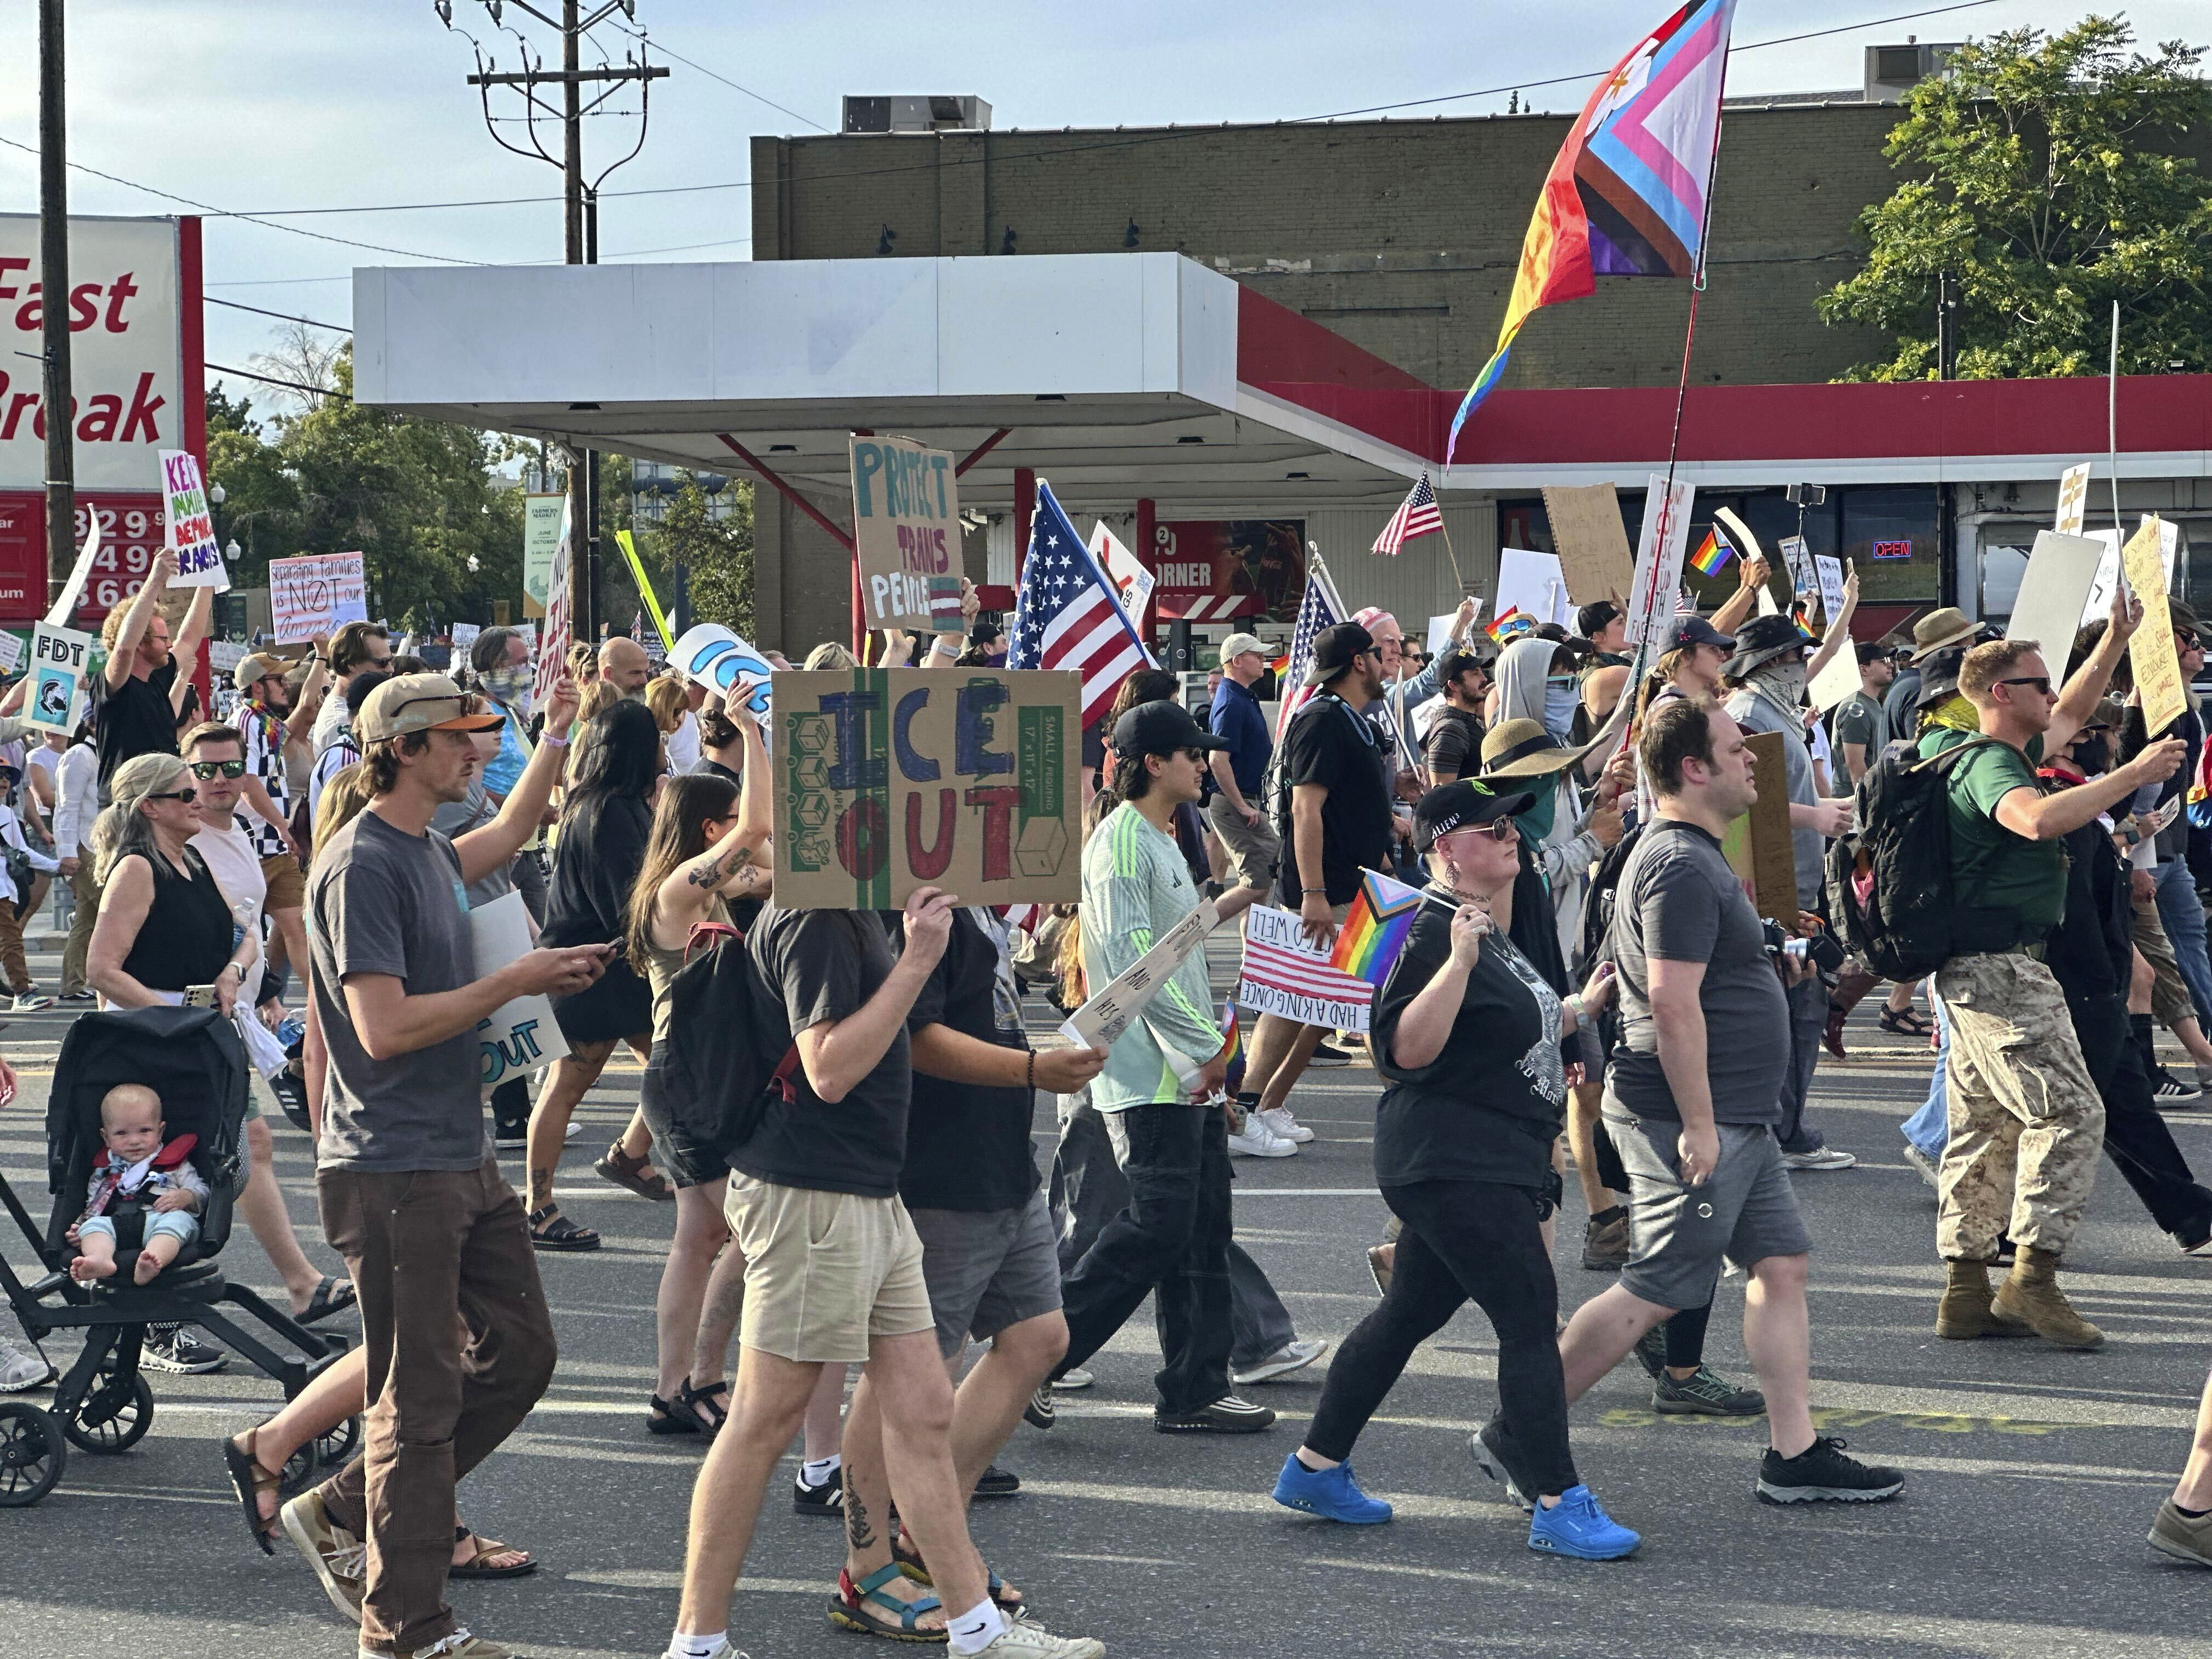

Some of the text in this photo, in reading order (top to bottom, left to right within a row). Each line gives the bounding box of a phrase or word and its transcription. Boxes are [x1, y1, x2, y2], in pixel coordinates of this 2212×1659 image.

[166, 454, 199, 493] KEE
[855, 443, 948, 519] PROTECT
[1660, 481, 1685, 506] TUMP
[896, 525, 948, 574] TRANS
[1159, 530, 1166, 540] 2
[1876, 543, 1909, 556] OPEN
[76, 545, 148, 573] 49
[179, 541, 223, 577] RACIS
[272, 556, 360, 589] separating families
[276, 578, 361, 614] is NOT our
[871, 572, 930, 619] PEOPLE
[37, 635, 84, 667] FDT
[819, 684, 1015, 790] ICE
[1045, 715, 1056, 755] SMALL
[834, 786, 1028, 882] OUT
[1252, 911, 1288, 942] WELL
[1125, 967, 1150, 990] AND
[1242, 983, 1276, 1009] ONCE
[1277, 992, 1313, 1020] KING
[1317, 997, 1325, 1021] A
[1330, 1006, 1357, 1029] HAD
[479, 1018, 543, 1083] OUT
